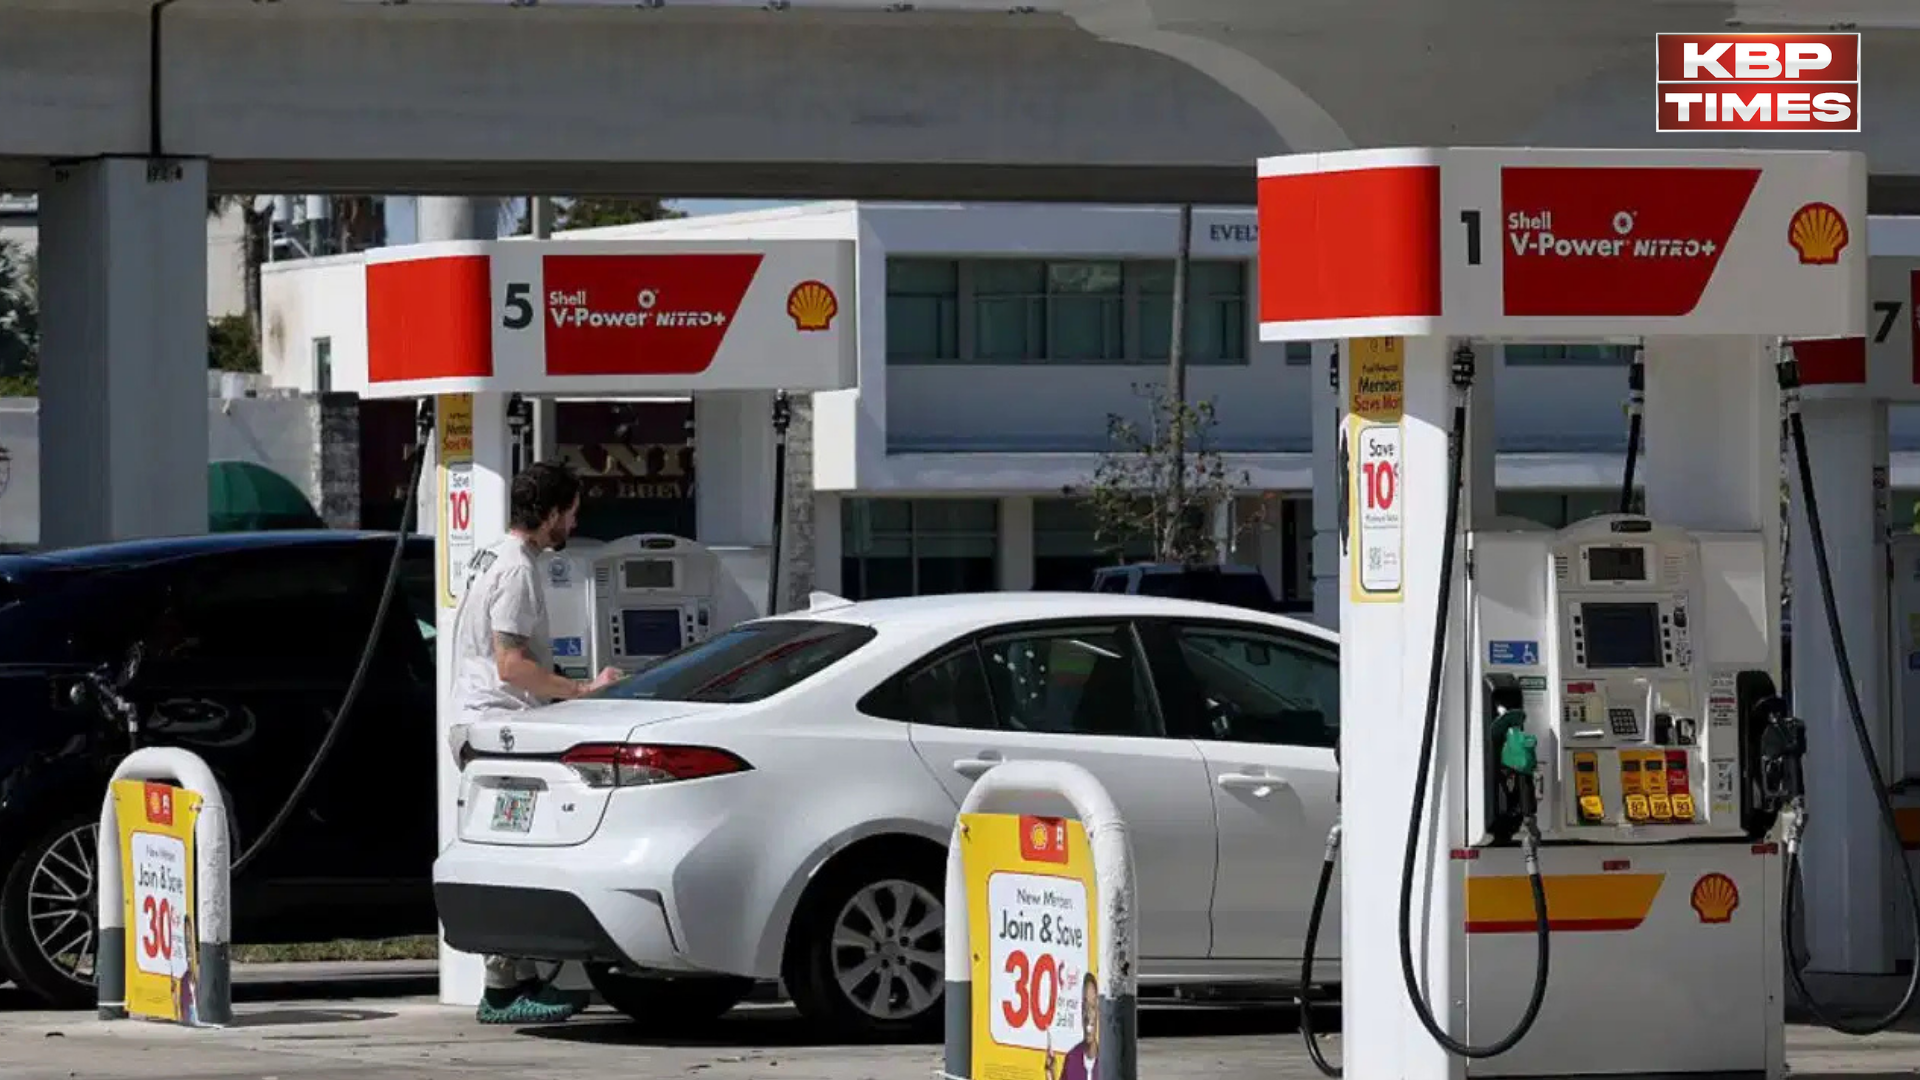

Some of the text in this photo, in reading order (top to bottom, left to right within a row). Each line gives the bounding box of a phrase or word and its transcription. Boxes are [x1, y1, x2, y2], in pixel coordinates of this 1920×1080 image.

[1508, 211, 1551, 230] Shell
[1460, 210, 1481, 265] 1
[1509, 232, 1626, 257] V-Power
[502, 283, 534, 330] 5
[549, 290, 587, 306] Shell
[550, 307, 648, 328] V-Power
[1873, 301, 1903, 343] 7
[1368, 438, 1395, 457] Save
[138, 862, 158, 889] Join
[1000, 908, 1083, 948] Join & Save
